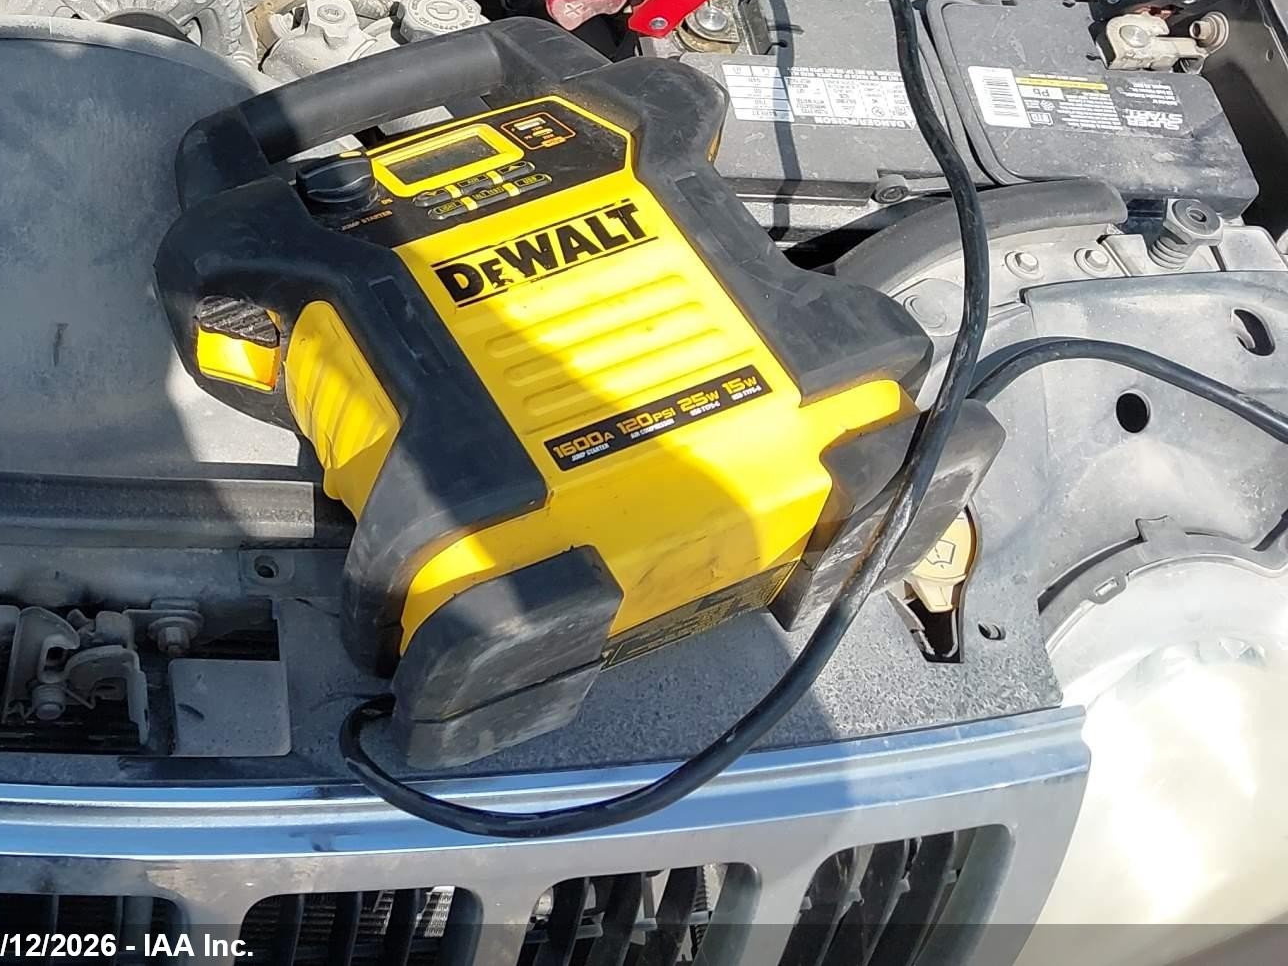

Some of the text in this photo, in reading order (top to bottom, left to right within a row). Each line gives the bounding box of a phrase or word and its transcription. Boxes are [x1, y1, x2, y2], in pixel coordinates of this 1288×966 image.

[552, 376, 757, 459] 1600A 120PSI 25W 15W
[585, 443, 610, 458] STARTER
